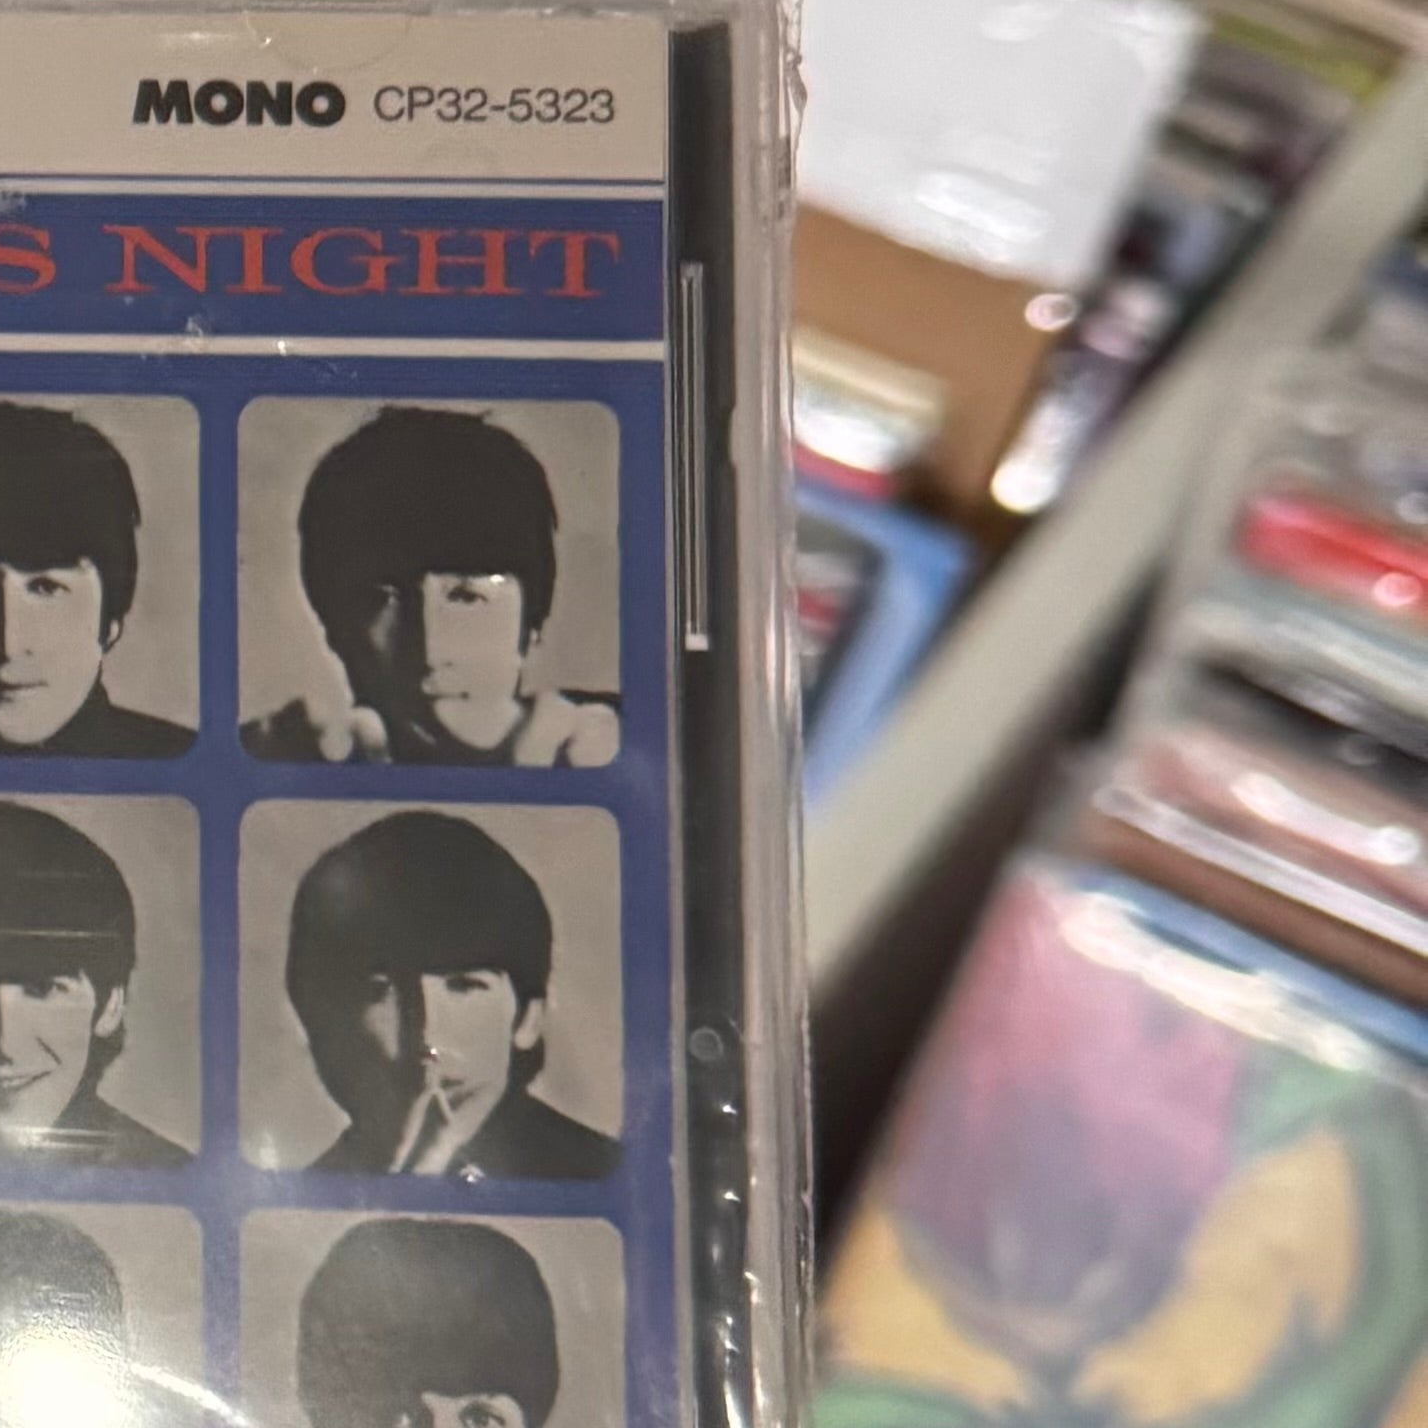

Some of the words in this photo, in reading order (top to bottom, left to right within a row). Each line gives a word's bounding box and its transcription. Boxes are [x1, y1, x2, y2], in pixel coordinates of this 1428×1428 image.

[132, 78, 346, 127] MONO
[373, 84, 615, 124] CP32-5323
[100, 222, 622, 300] NIGHT
